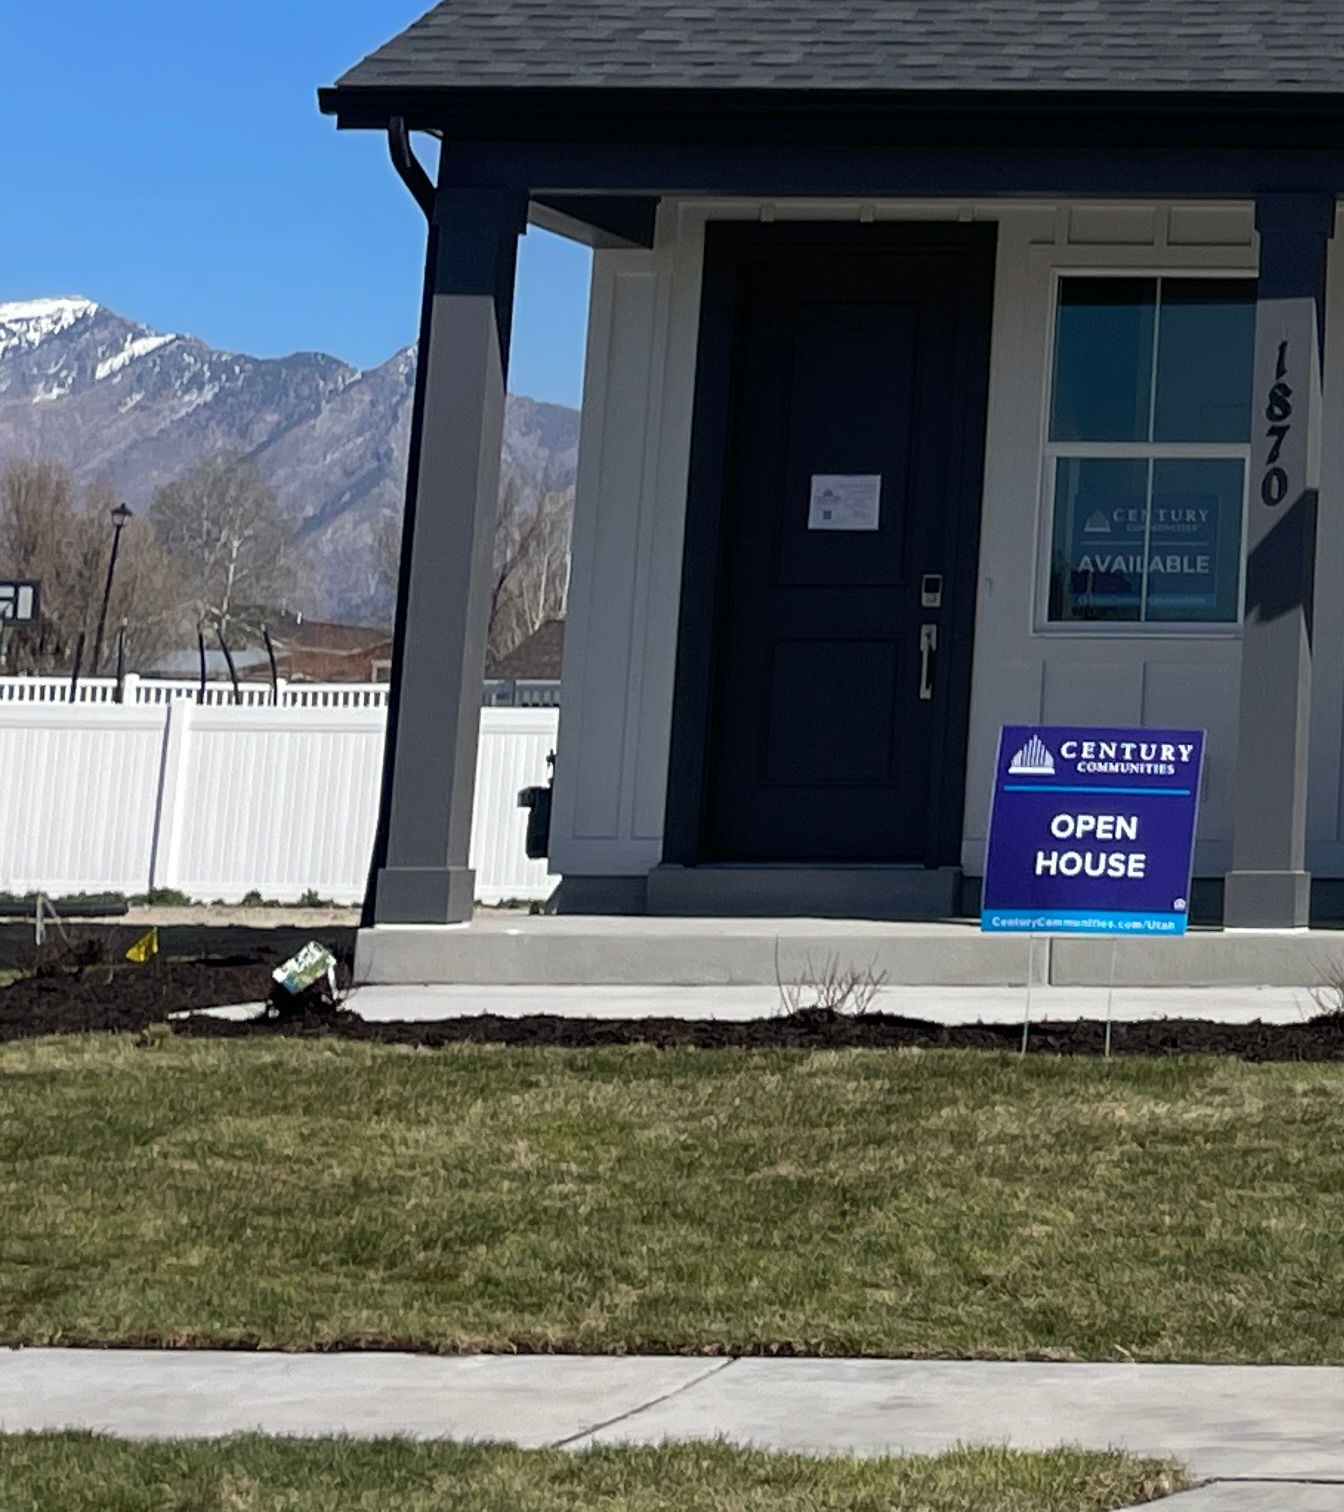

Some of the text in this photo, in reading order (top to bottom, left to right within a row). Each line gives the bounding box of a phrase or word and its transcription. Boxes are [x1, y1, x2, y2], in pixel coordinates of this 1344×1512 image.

[1261, 341, 1293, 507] 1870
[1112, 508, 1209, 523] CENTURY
[1077, 554, 1210, 574] AVAILABLE
[1060, 741, 1194, 762] CENTURY
[1077, 761, 1175, 775] COMMUNITIES
[1051, 814, 1138, 840] OPEN
[1035, 851, 1147, 878] HOUSE
[991, 915, 1176, 931] CenturyCommunities.com/Utah
